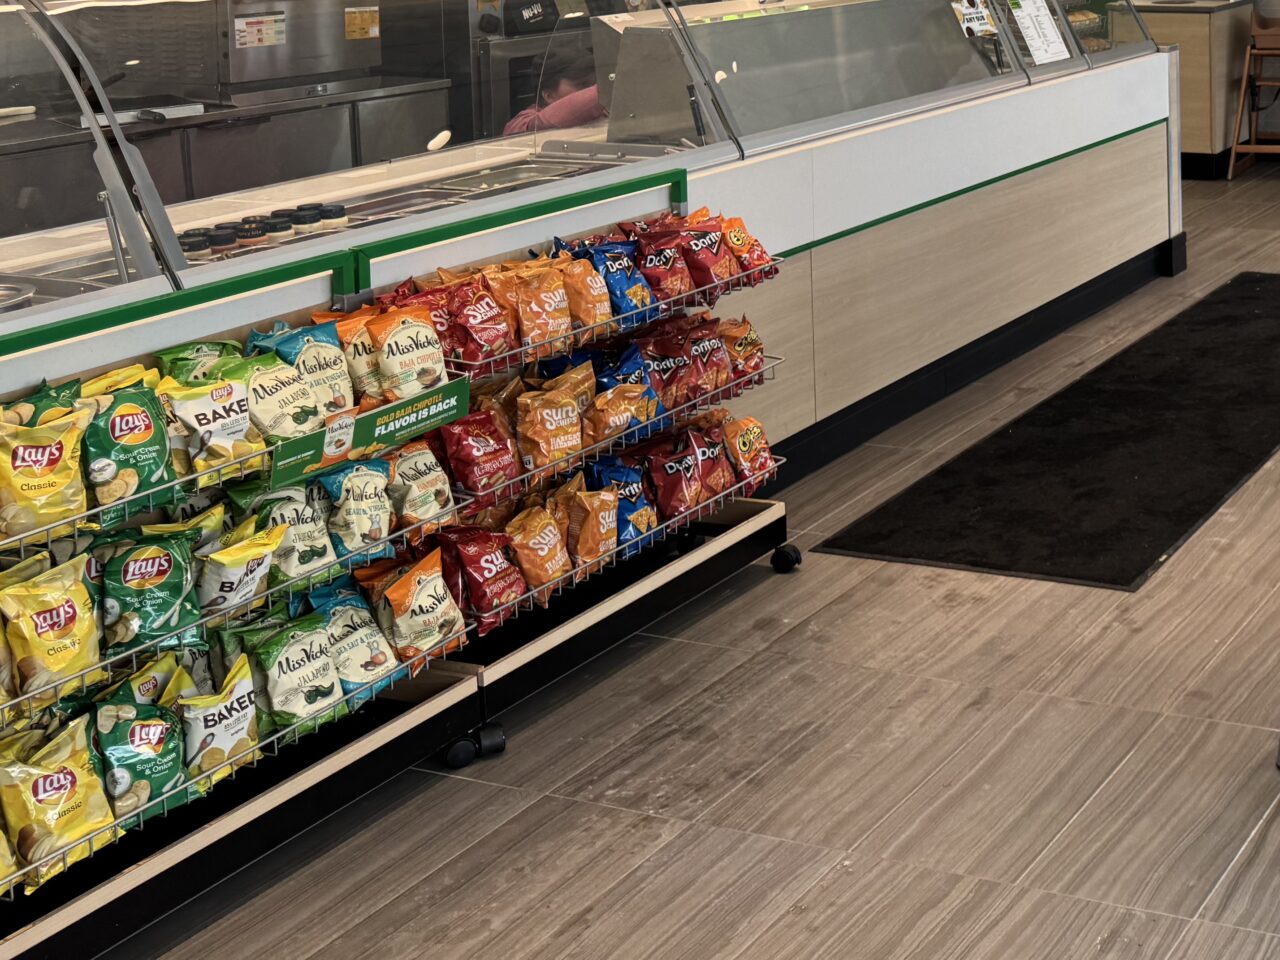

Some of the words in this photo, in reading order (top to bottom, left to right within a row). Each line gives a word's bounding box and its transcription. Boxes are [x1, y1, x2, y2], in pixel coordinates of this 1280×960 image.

[965, 16, 976, 24] ANY
[541, 289, 568, 311] Sun
[464, 297, 497, 324] Sun
[691, 338, 722, 356] oritos
[400, 358, 416, 370] BAJA
[416, 350, 443, 365] CHIPOTLE
[213, 384, 233, 402] Lay's
[194, 397, 248, 427] BAKE
[374, 414, 416, 438] FLAVOR
[417, 409, 429, 421] IS
[429, 395, 458, 415] BACK
[376, 415, 395, 425] BOLD
[395, 406, 412, 420] BAJA
[412, 393, 443, 412] CHIPOTLE
[543, 406, 578, 430] Sun
[113, 411, 151, 437] Lay's
[555, 416, 578, 427] CHIPS
[14, 441, 61, 468] Lay's
[119, 449, 137, 461] Sour
[137, 444, 161, 456] Cream
[129, 456, 136, 464] &
[137, 452, 158, 463] Onion
[20, 480, 57, 492] Classic
[528, 525, 558, 557] Sun
[125, 555, 170, 580] Lay's
[126, 595, 145, 603] Sour
[146, 590, 170, 599] Cream
[134, 600, 141, 608] &
[142, 597, 163, 607] Onion
[33, 601, 75, 632] Lay's
[336, 645, 348, 656] SEA
[297, 661, 330, 688] JALAPEÑO
[138, 676, 158, 695] Lay's
[134, 722, 171, 746] Lay's
[136, 762, 155, 772] Sour
[156, 752, 177, 765] Cream
[144, 767, 151, 775] &
[151, 761, 174, 774] Onion
[51, 800, 82, 820] Classic
